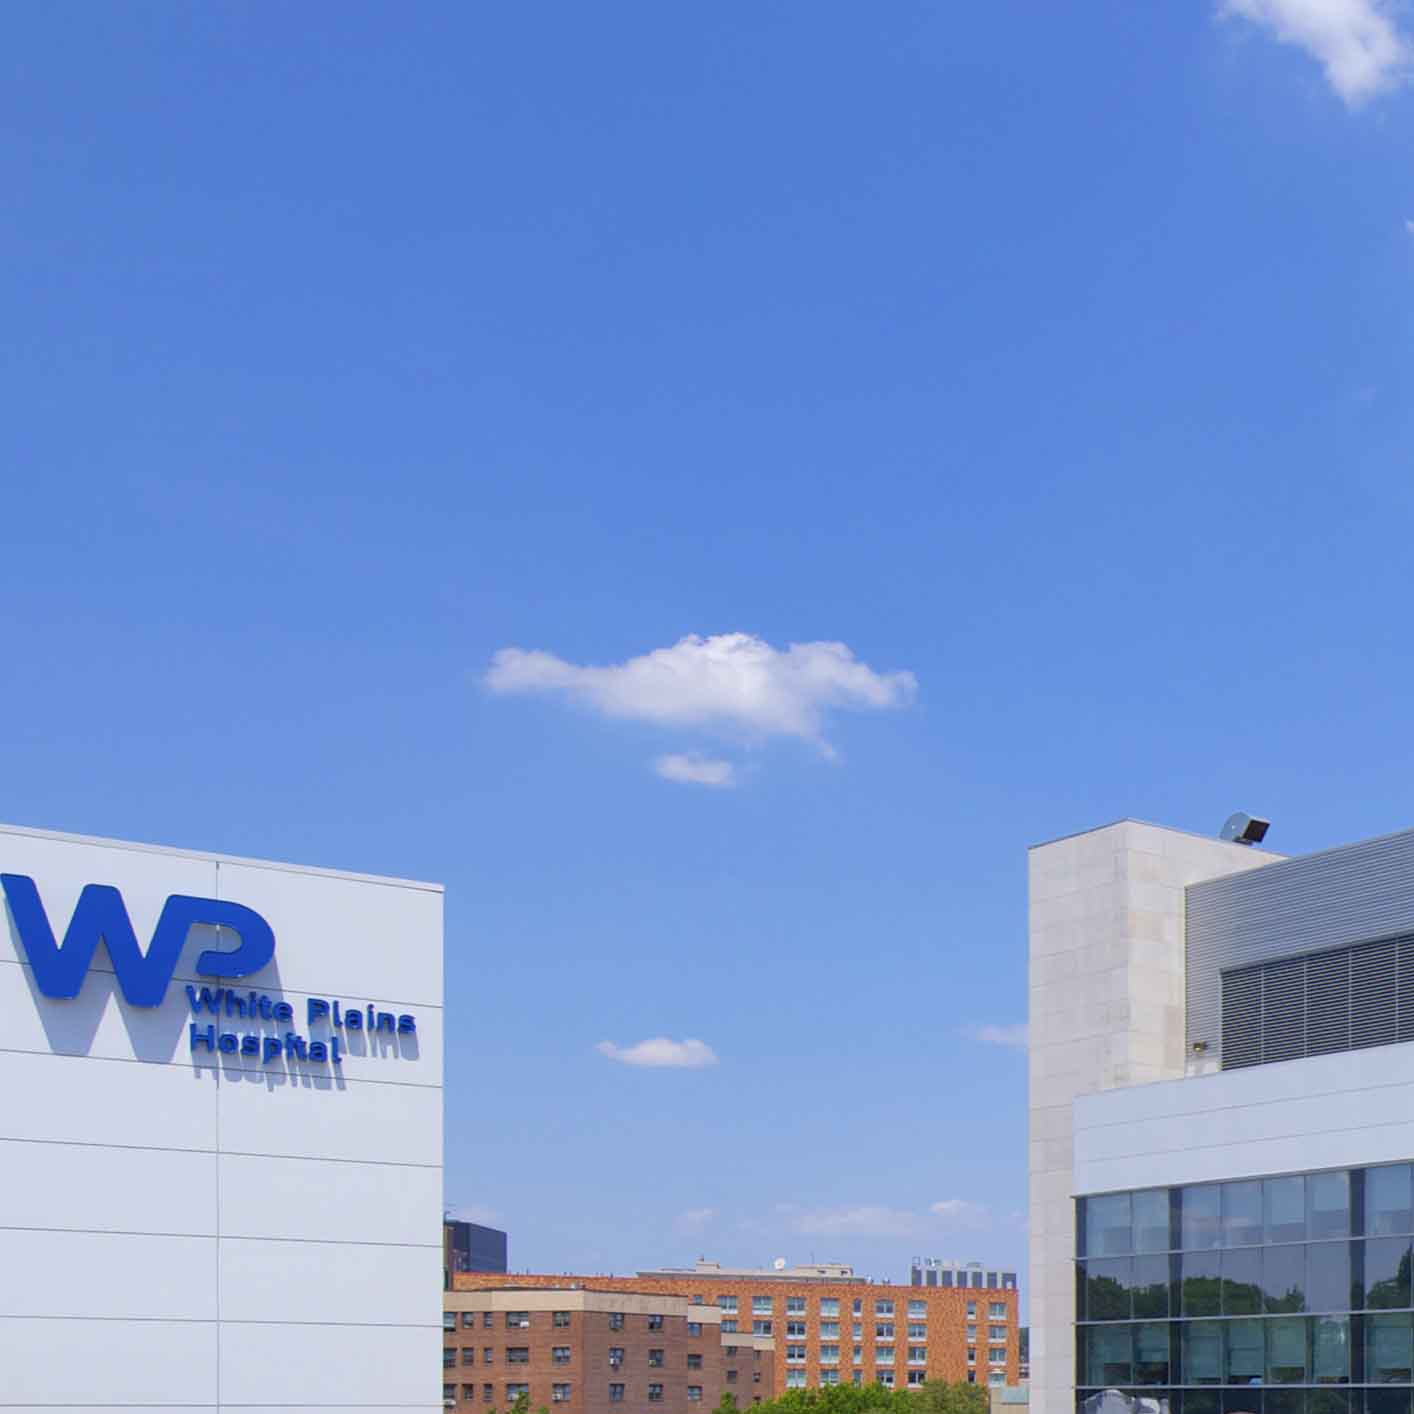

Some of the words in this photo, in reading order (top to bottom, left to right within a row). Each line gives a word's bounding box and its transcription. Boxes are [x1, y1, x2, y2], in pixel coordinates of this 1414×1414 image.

[186, 985, 294, 1022] White
[307, 998, 417, 1034] Plains
[190, 1022, 343, 1065] Hospital
